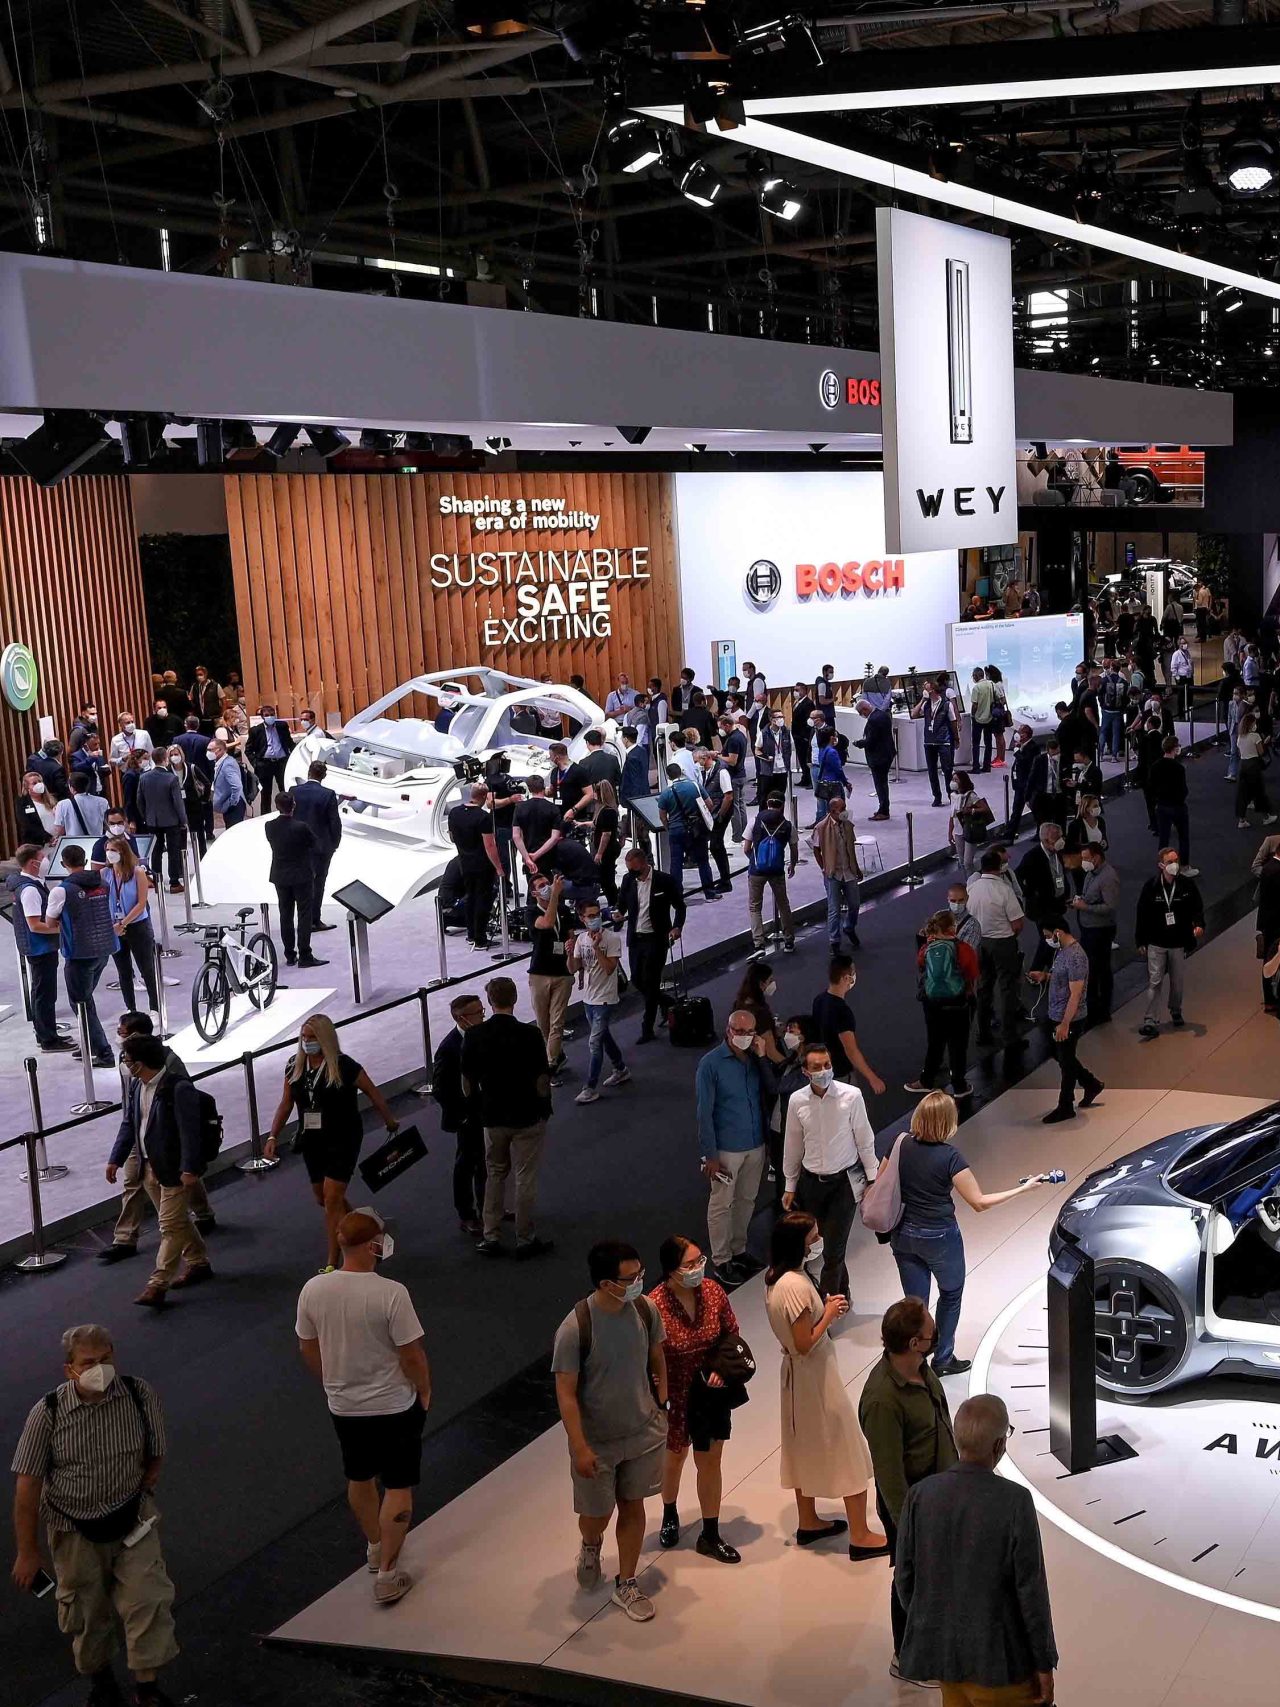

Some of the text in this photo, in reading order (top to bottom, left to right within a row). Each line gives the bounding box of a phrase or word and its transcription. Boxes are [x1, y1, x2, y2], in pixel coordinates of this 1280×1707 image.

[439, 495, 566, 516] Shaping a new
[916, 486, 1006, 518] WEY
[475, 511, 600, 531] era of mobility
[430, 547, 650, 588] SUSTAINABLE
[796, 560, 904, 595] BOSCH
[517, 581, 611, 617] SAFE
[483, 613, 612, 646] EXCITING
[723, 645, 730, 654] P
[1203, 1433, 1239, 1455] A
